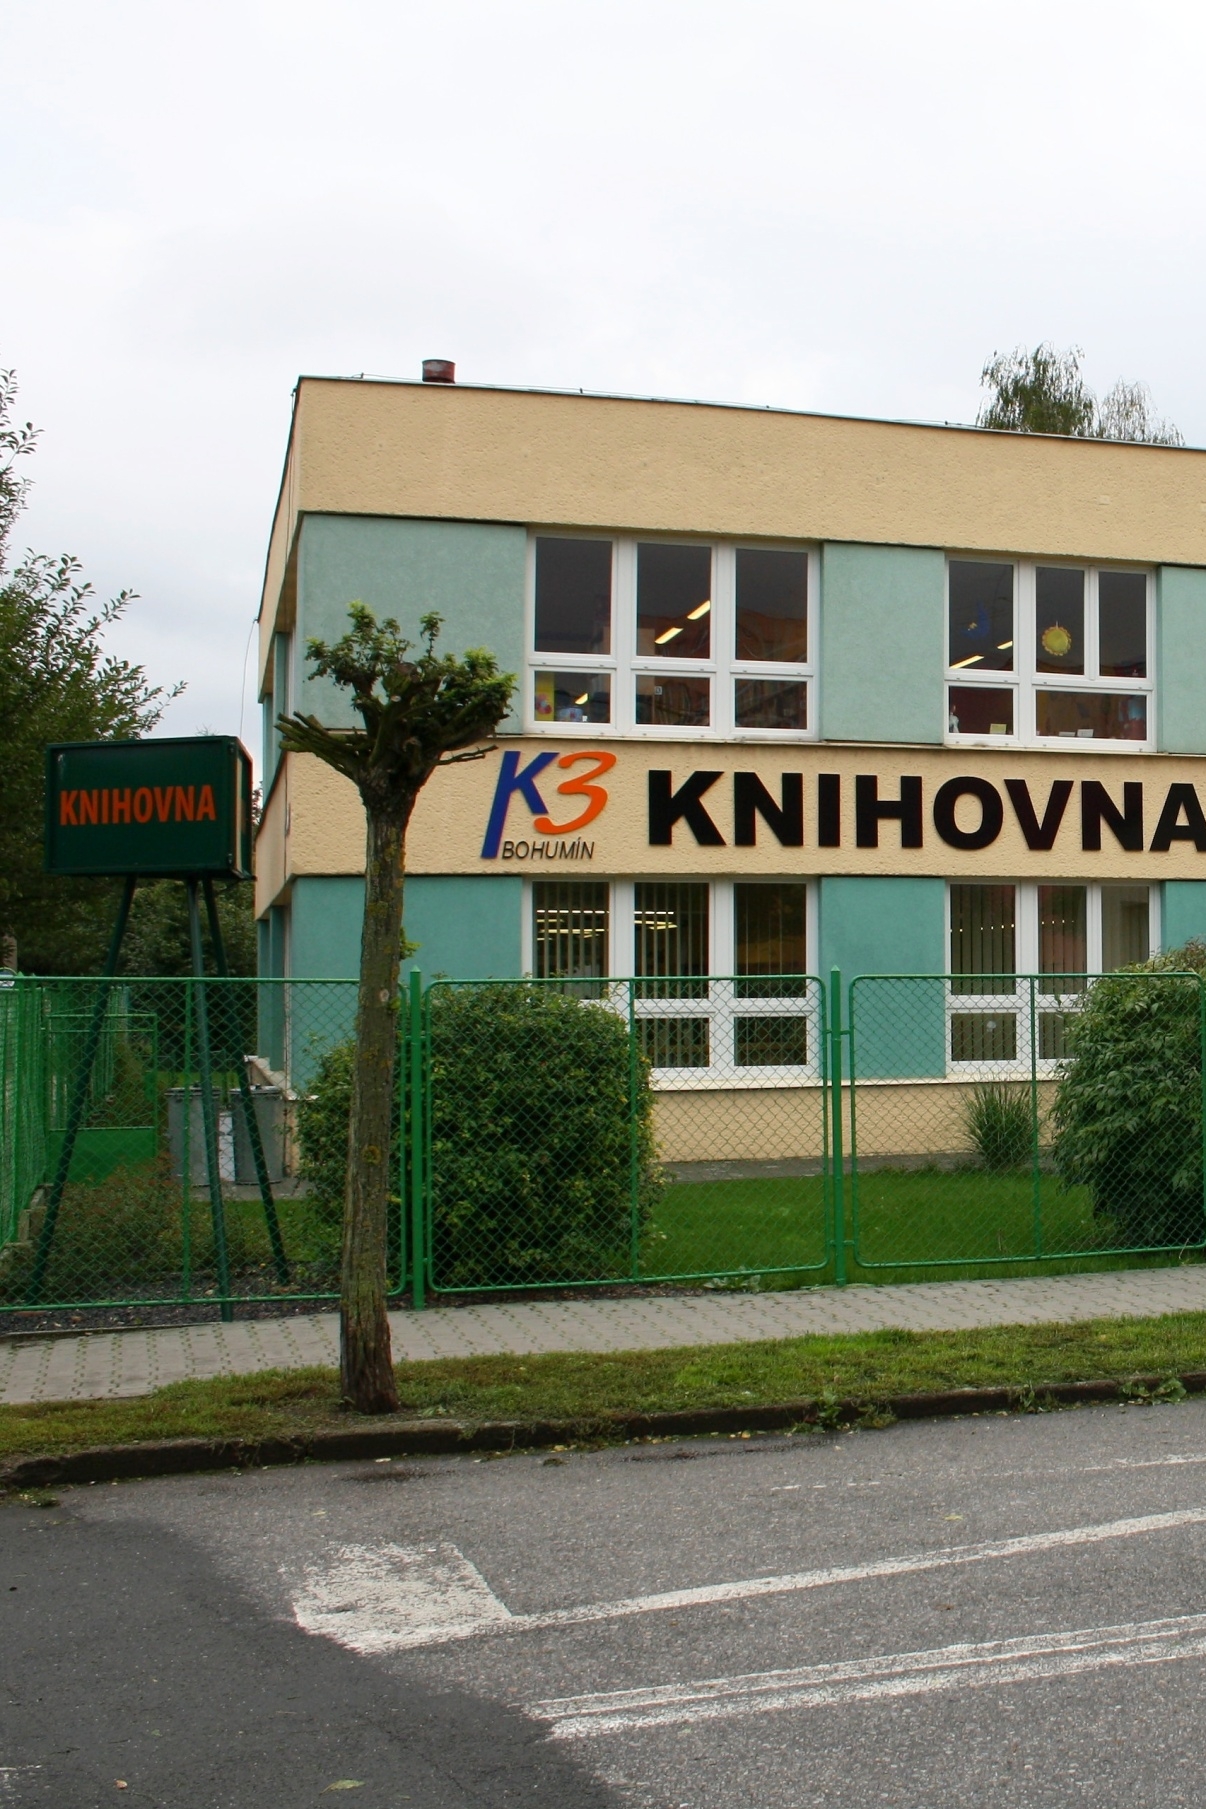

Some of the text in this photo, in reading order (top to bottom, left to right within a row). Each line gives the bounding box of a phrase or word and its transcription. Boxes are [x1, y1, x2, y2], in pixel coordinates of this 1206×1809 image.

[59, 784, 216, 826] KNIHOVNA
[481, 750, 617, 859] K3
[501, 837, 595, 860] BOHUMÍN
